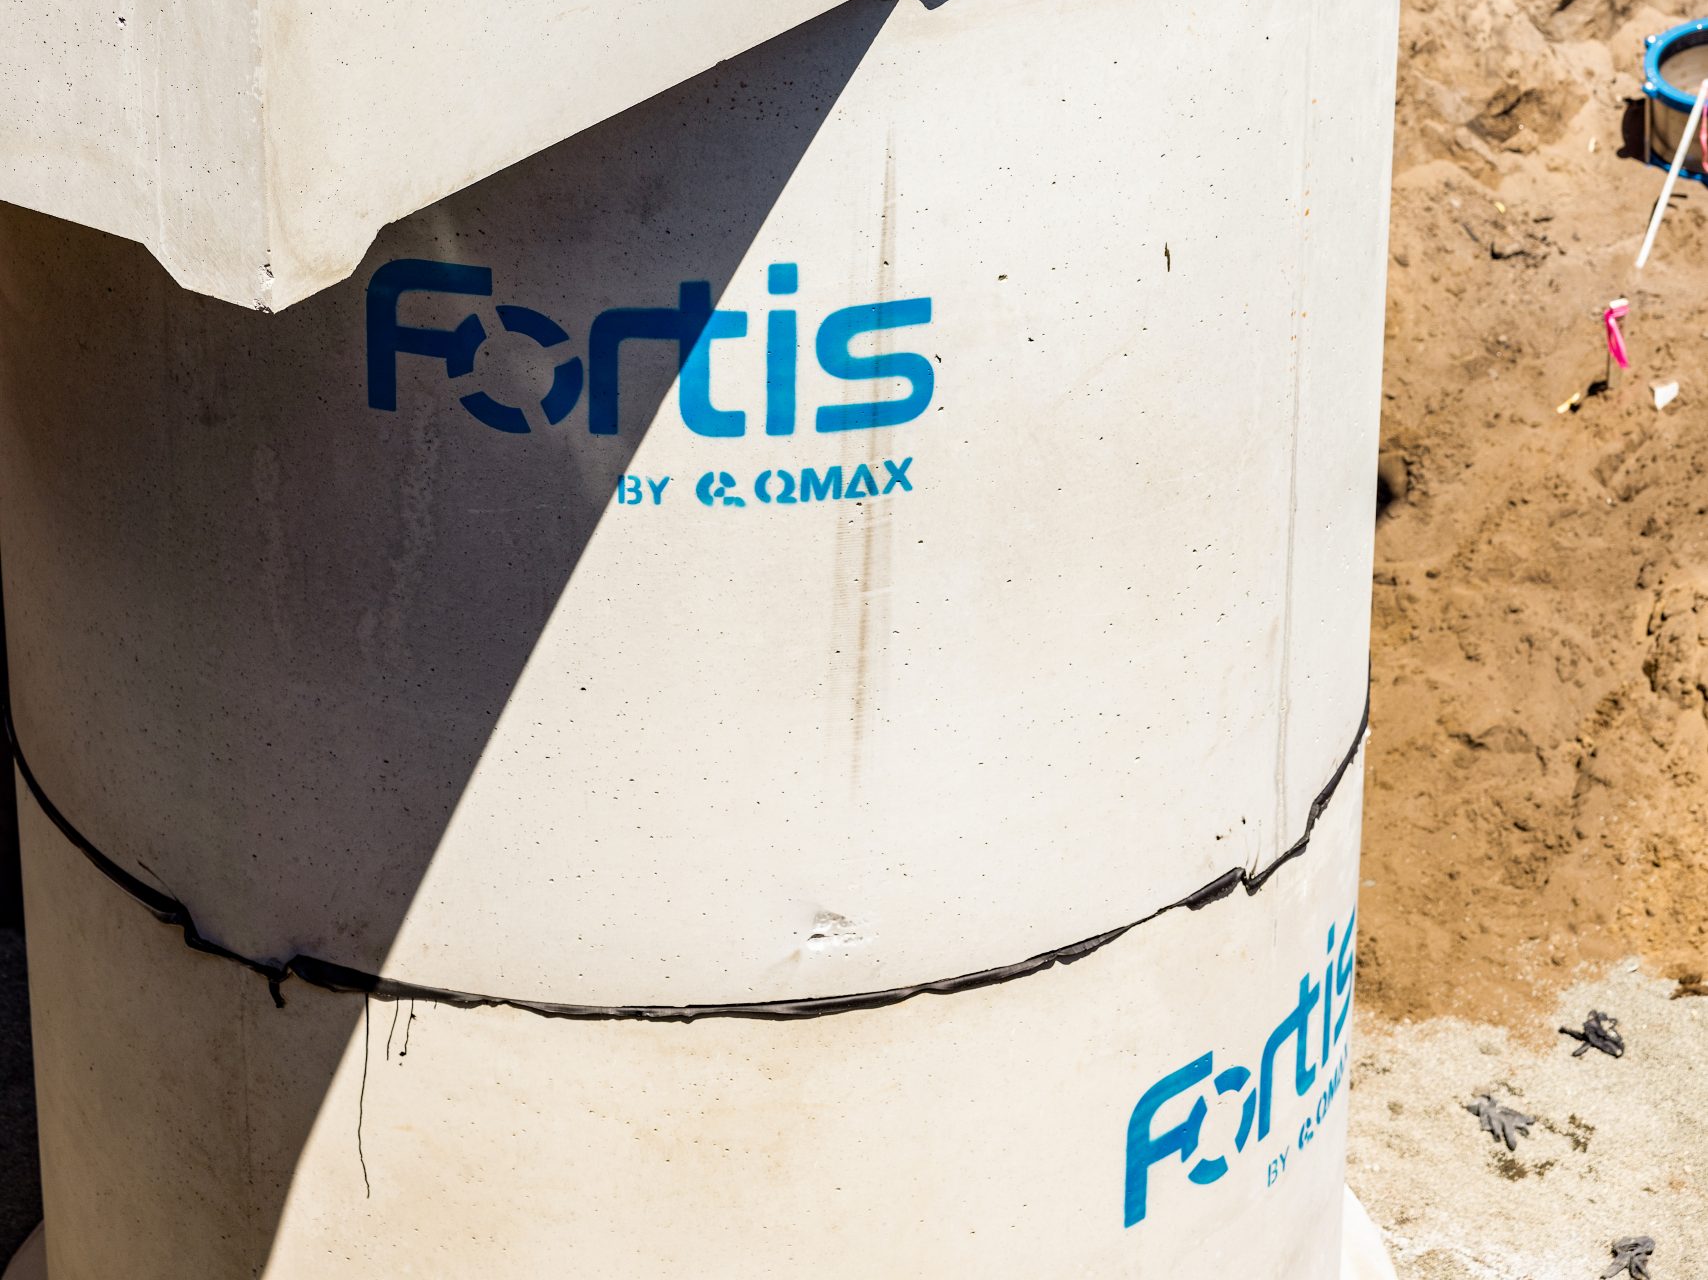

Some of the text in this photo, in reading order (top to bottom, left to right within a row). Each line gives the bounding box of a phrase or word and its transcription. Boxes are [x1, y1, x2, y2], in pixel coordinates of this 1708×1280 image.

[366, 258, 936, 438] Fortis
[617, 456, 914, 506] BY QMAX
[1268, 1145, 1290, 1188] BY
